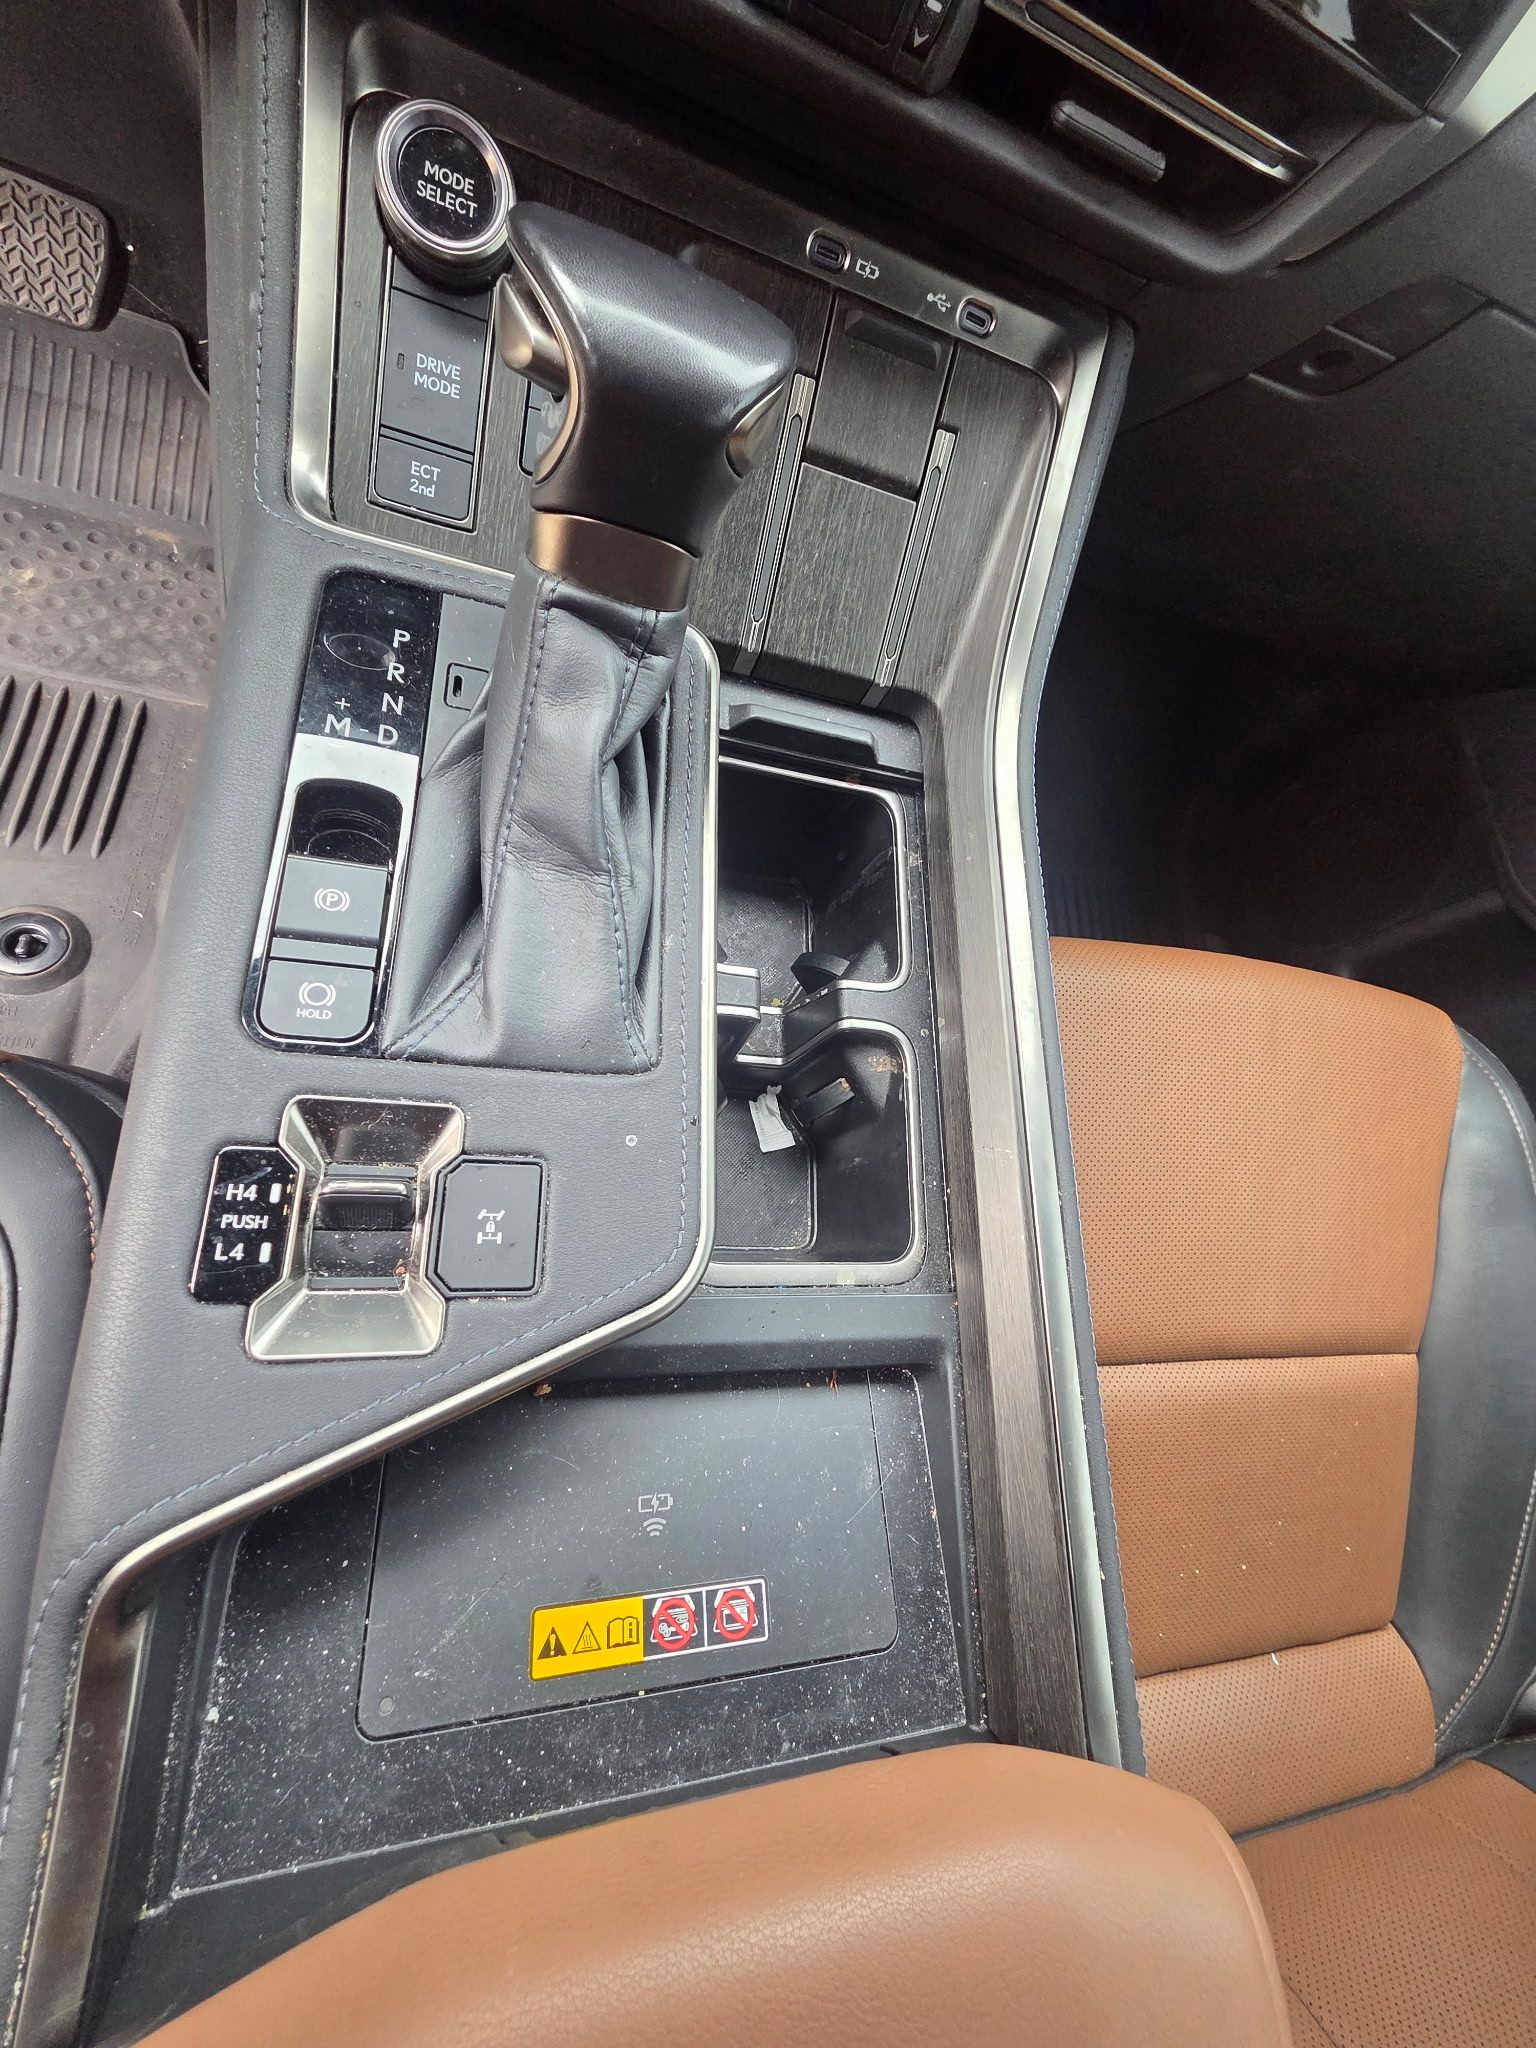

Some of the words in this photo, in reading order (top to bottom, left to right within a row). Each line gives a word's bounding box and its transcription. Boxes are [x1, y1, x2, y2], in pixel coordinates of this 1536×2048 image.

[424, 160, 475, 196] MODE
[416, 180, 478, 218] SELECT
[416, 352, 461, 381] DRIVE
[414, 371, 461, 399] MODE
[410, 460, 441, 482] ECT
[409, 478, 436, 498] 2nd
[393, 628, 411, 648] P
[387, 662, 405, 684] R
[381, 692, 404, 716] N
[324, 713, 352, 738] M
[377, 724, 399, 745] D
[296, 1007, 332, 1020] HOLD
[226, 1183, 258, 1202] H4
[220, 1214, 269, 1230] PUSH
[214, 1242, 245, 1261] L4
